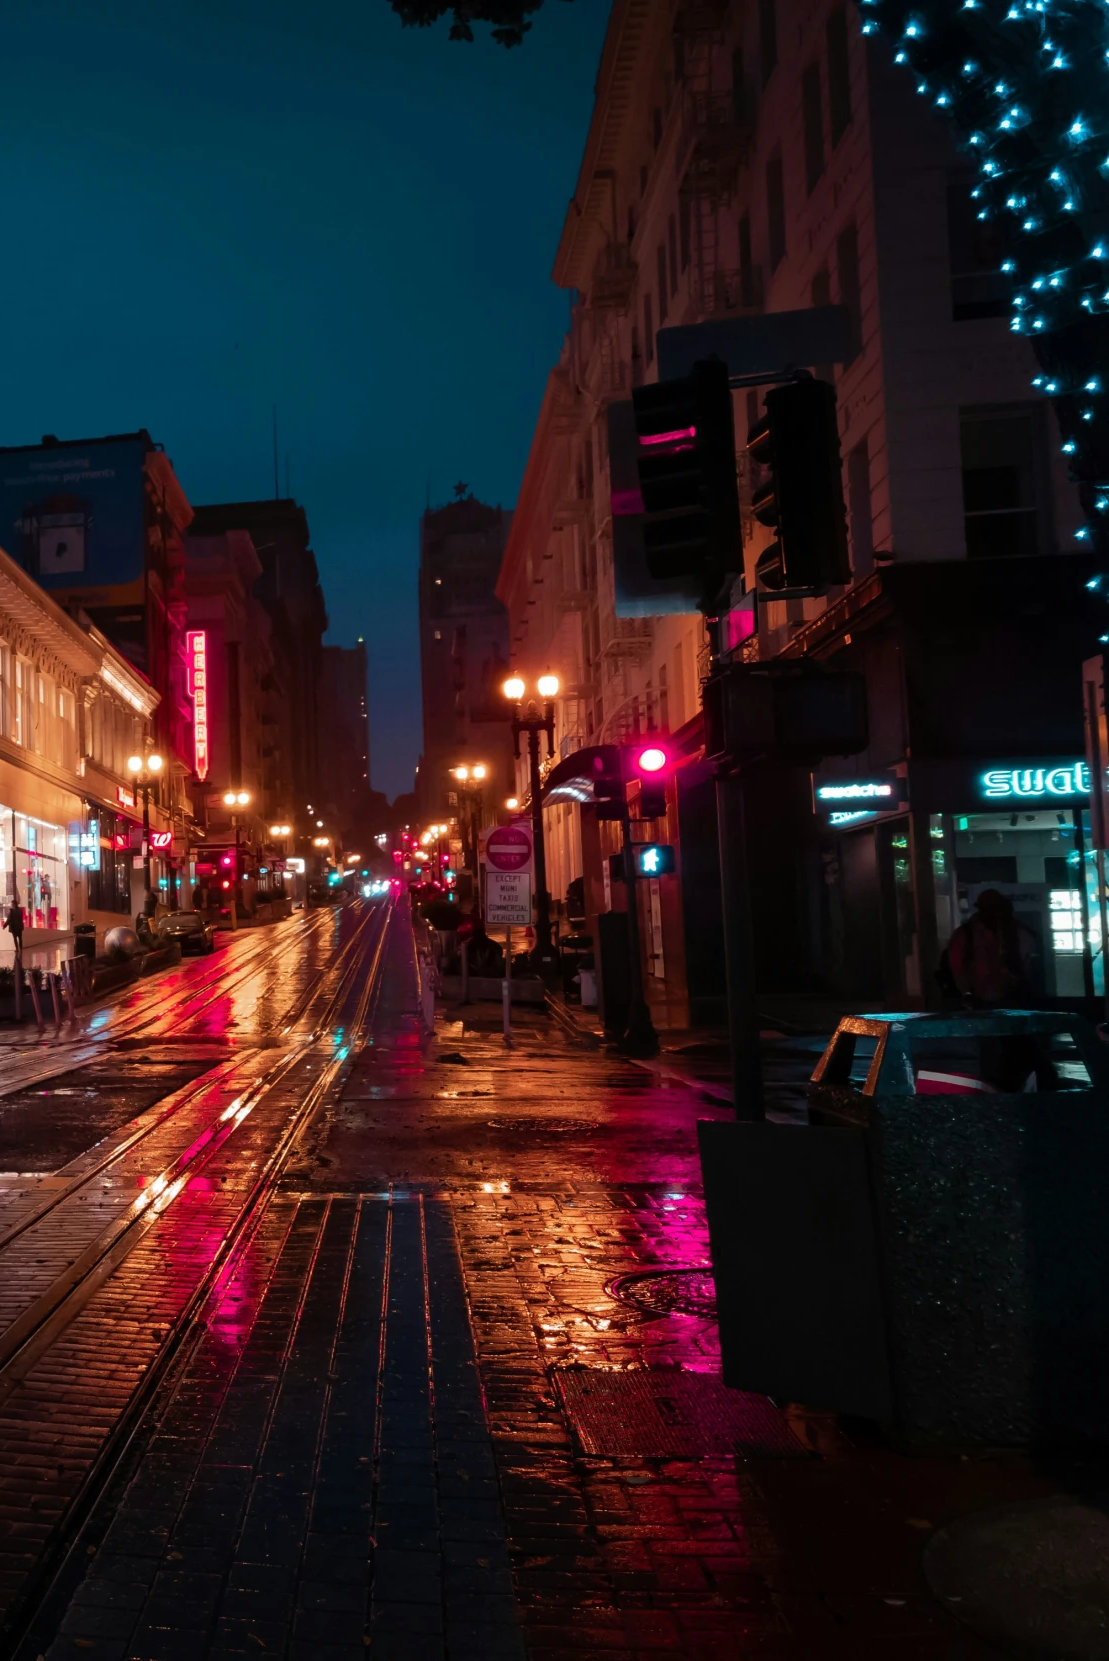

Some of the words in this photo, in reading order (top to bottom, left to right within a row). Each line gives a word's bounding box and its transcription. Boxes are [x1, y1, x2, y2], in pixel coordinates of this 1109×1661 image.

[63, 468, 115, 482] payments
[193, 635, 206, 758] HERBERT
[495, 855, 521, 863] ENTER
[488, 904, 528, 912] COMMERCIAL
